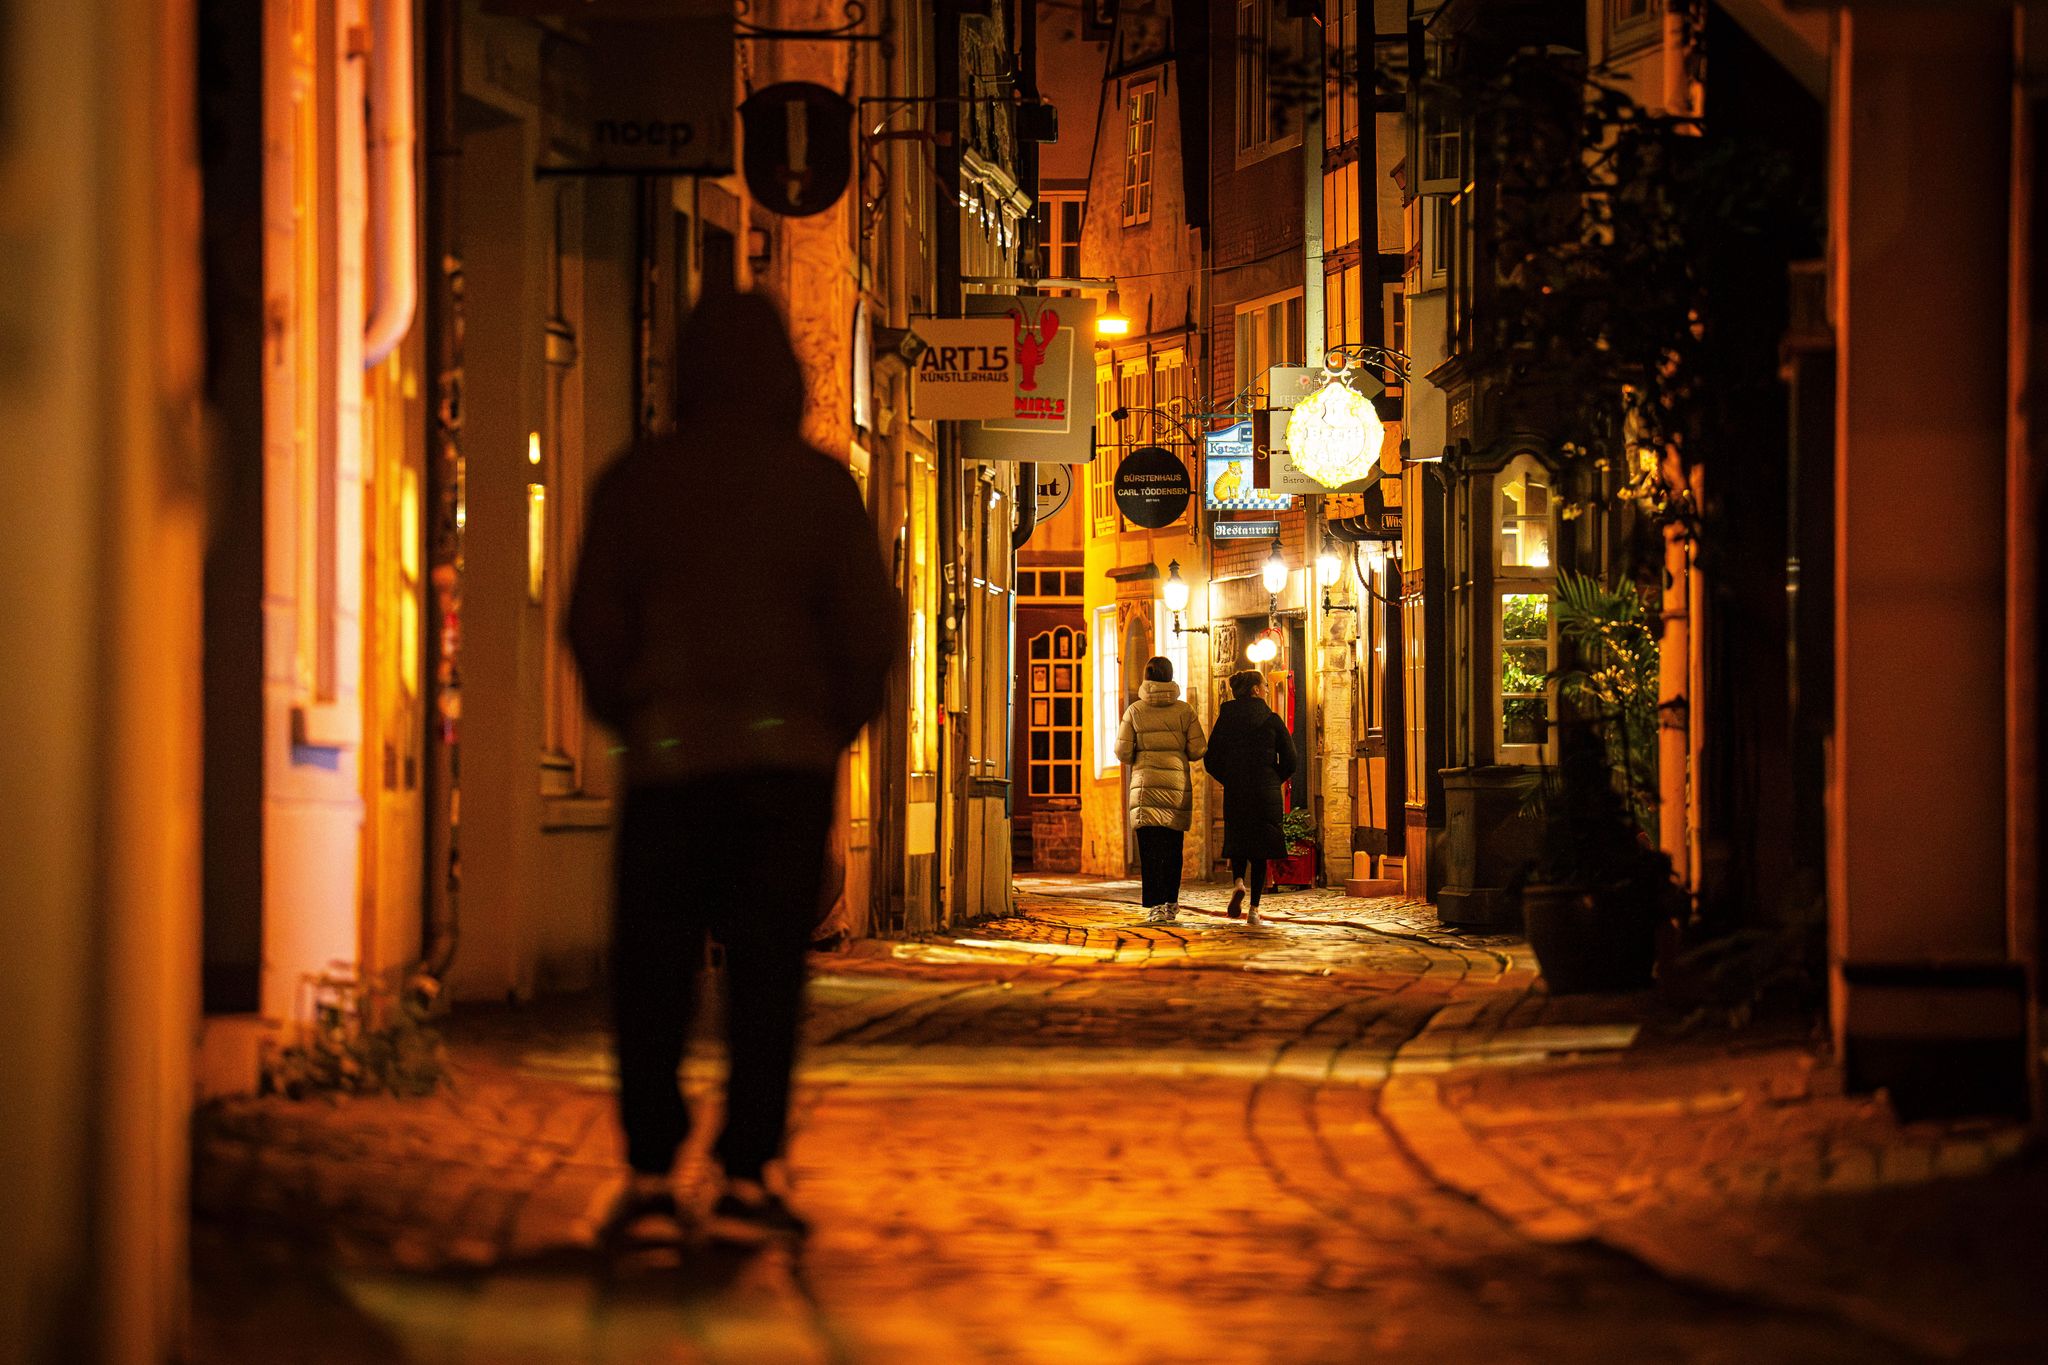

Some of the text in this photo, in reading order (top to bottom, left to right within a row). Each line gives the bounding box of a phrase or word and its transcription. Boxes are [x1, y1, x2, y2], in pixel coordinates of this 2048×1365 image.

[921, 346, 1009, 371] ART15
[920, 371, 1009, 383] KÜNSTLERHAUS
[1123, 473, 1182, 483] BÜRSTENHAUS
[1282, 475, 1305, 484] Bistro
[1117, 487, 1188, 496] CARL TÖDDENSEN
[1215, 525, 1279, 536] Restaurant
